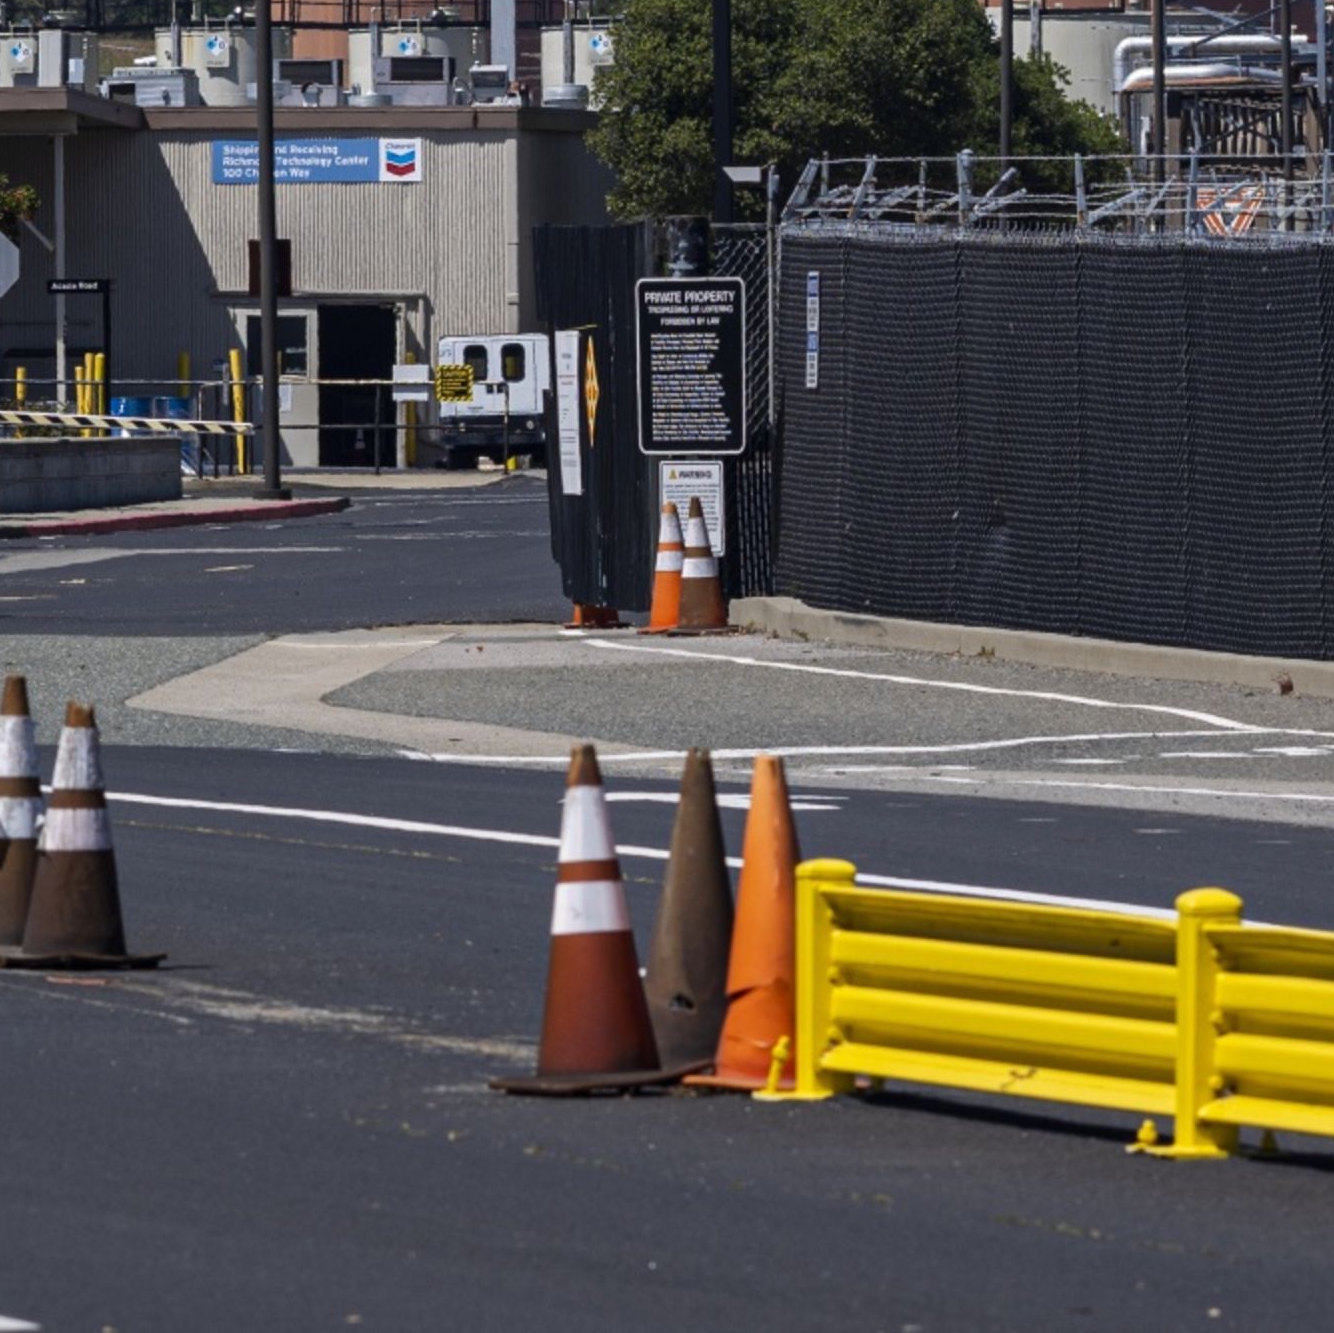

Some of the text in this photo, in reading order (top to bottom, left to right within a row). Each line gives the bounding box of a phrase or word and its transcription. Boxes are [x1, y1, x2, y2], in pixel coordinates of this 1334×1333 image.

[223, 145, 260, 155] Shippin
[290, 145, 338, 155] Receiving
[223, 156, 369, 167] Richm Technology Center
[223, 168, 310, 179] 100 Chon Way
[644, 290, 736, 303] PRIVATE PROPERTY
